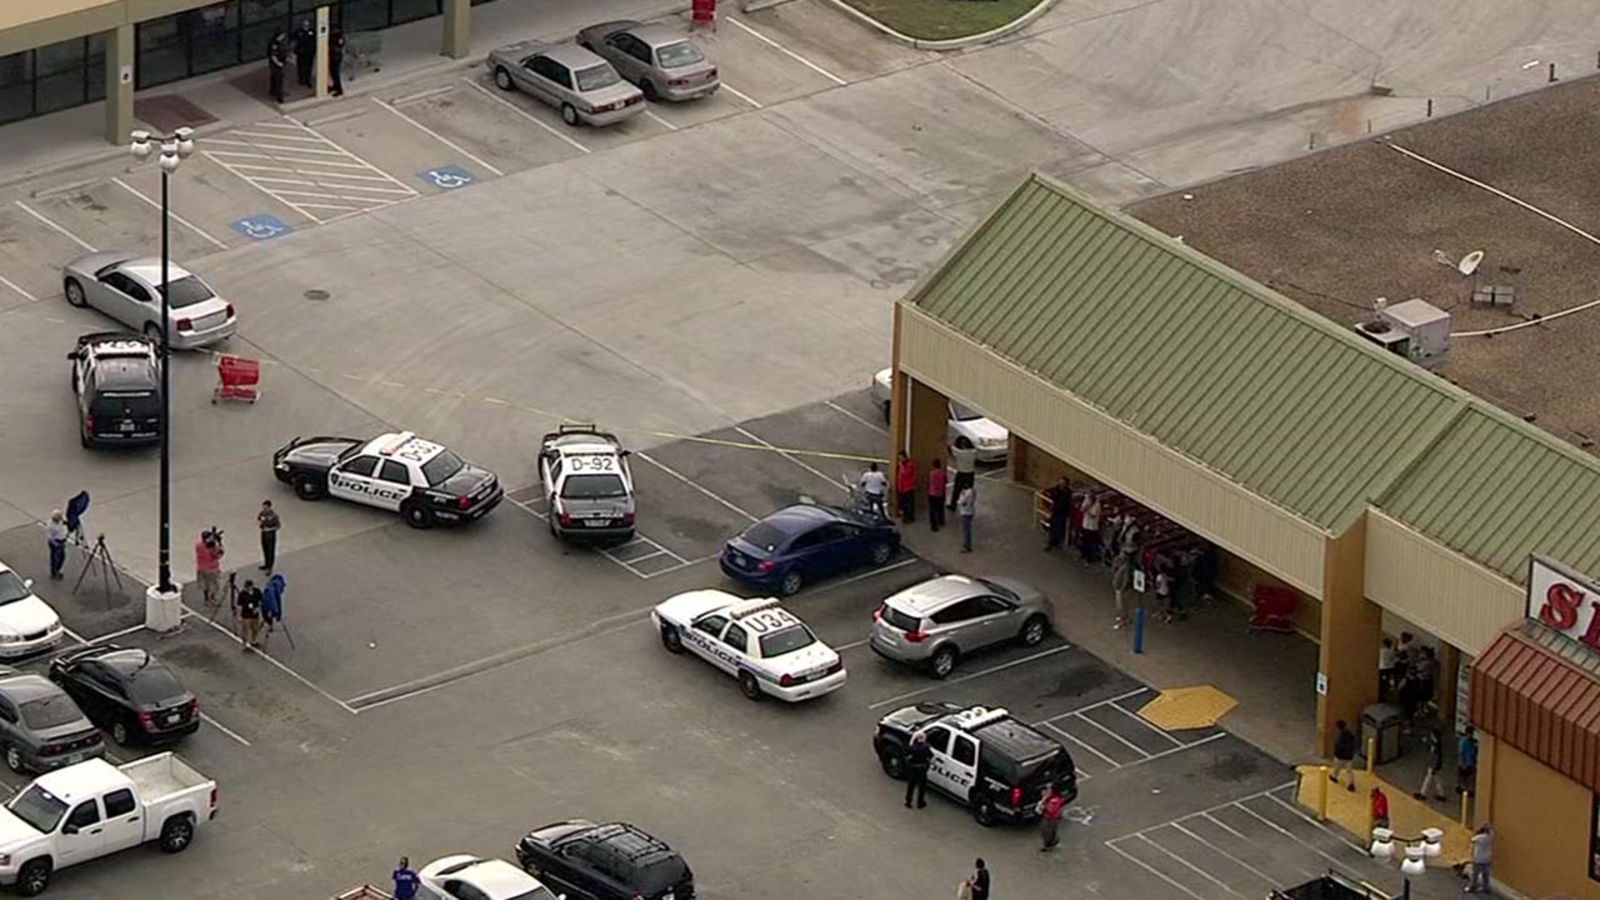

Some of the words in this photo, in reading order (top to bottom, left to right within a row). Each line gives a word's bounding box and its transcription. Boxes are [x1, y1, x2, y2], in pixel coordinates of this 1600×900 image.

[571, 457, 614, 471] D-92
[338, 480, 406, 501] POLICE
[745, 611, 797, 633] U34
[689, 634, 741, 667] POLICE
[929, 762, 970, 788] OLICE
